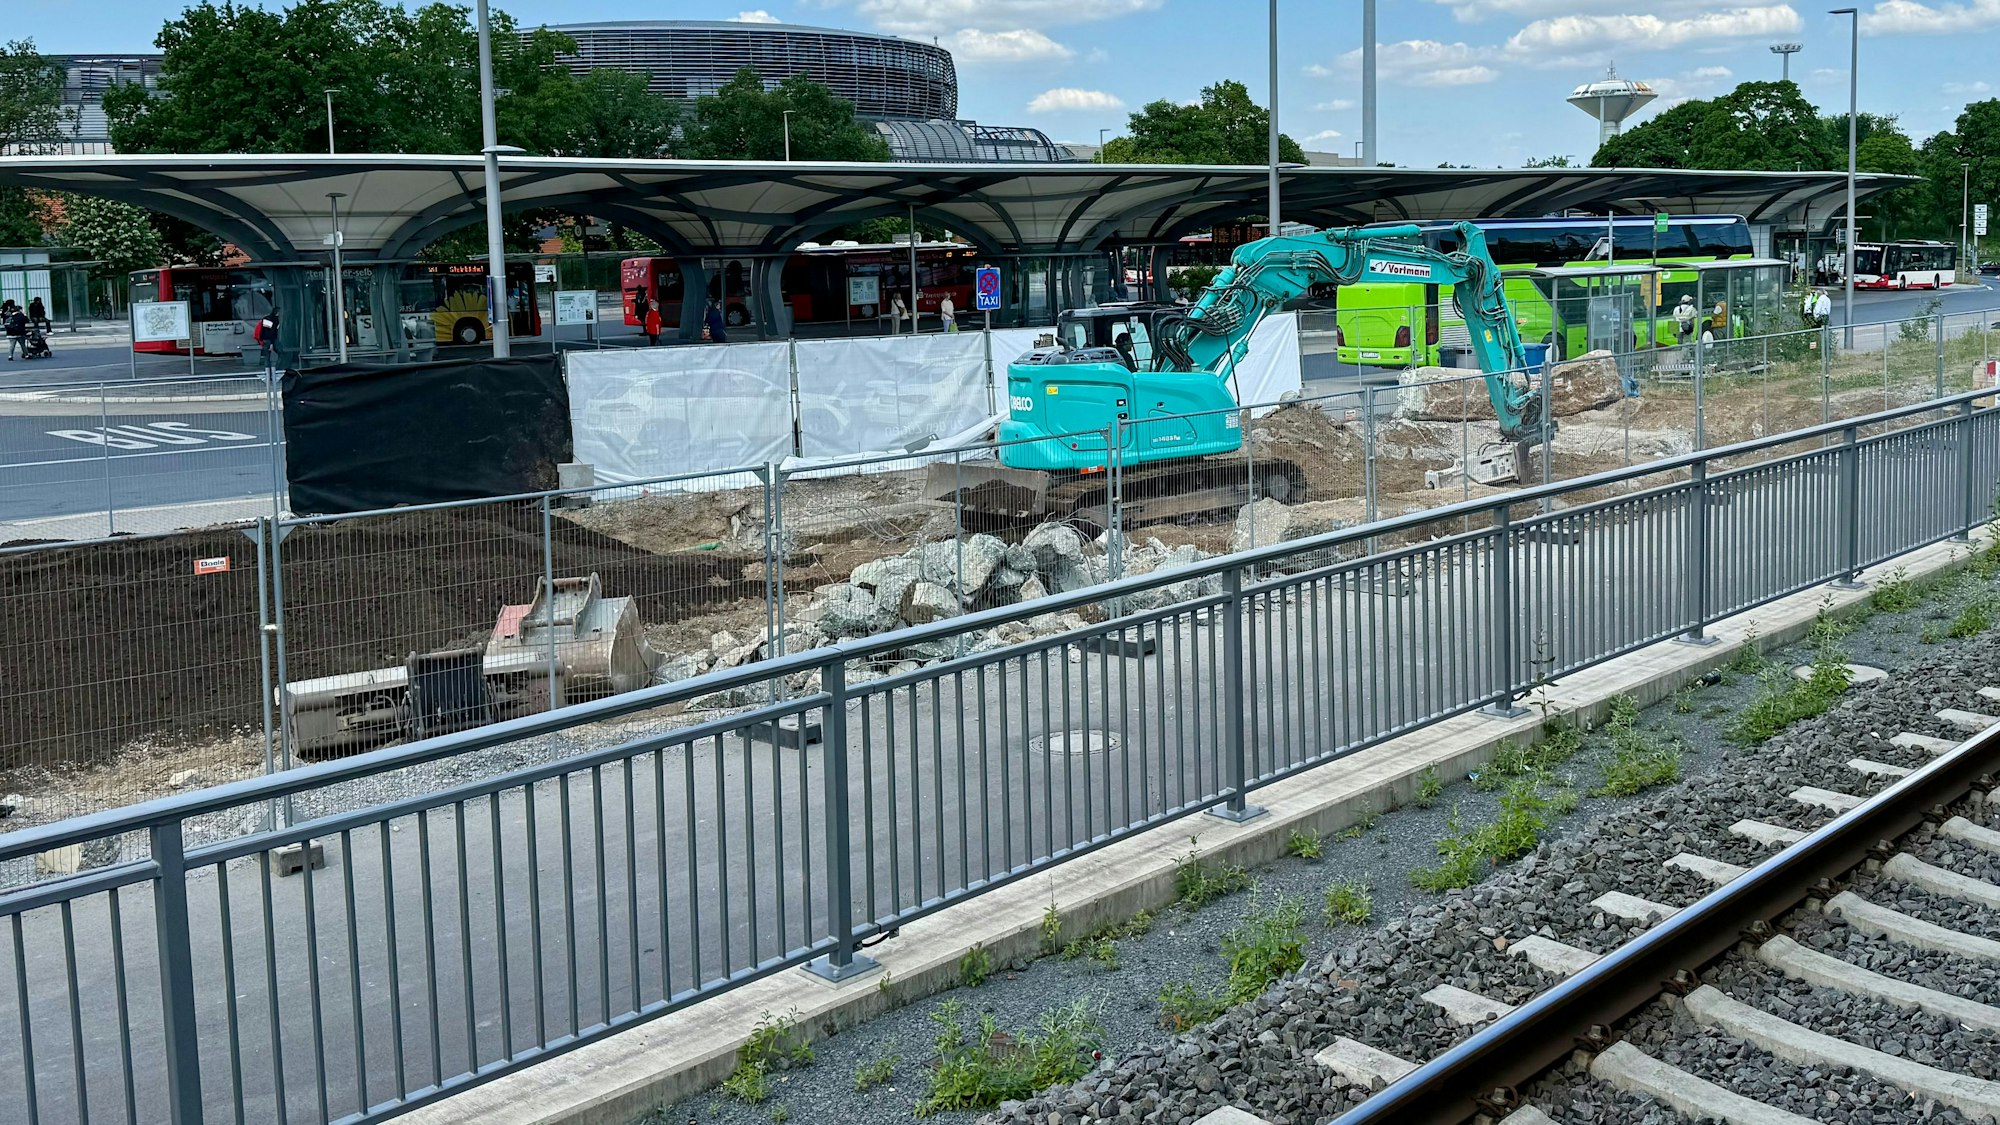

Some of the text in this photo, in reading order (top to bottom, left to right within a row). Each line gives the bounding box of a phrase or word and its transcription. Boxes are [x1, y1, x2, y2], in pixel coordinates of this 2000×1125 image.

[1388, 264, 1430, 277] Vortmann
[980, 296, 998, 306] TAXI
[45, 422, 257, 449] BUS
